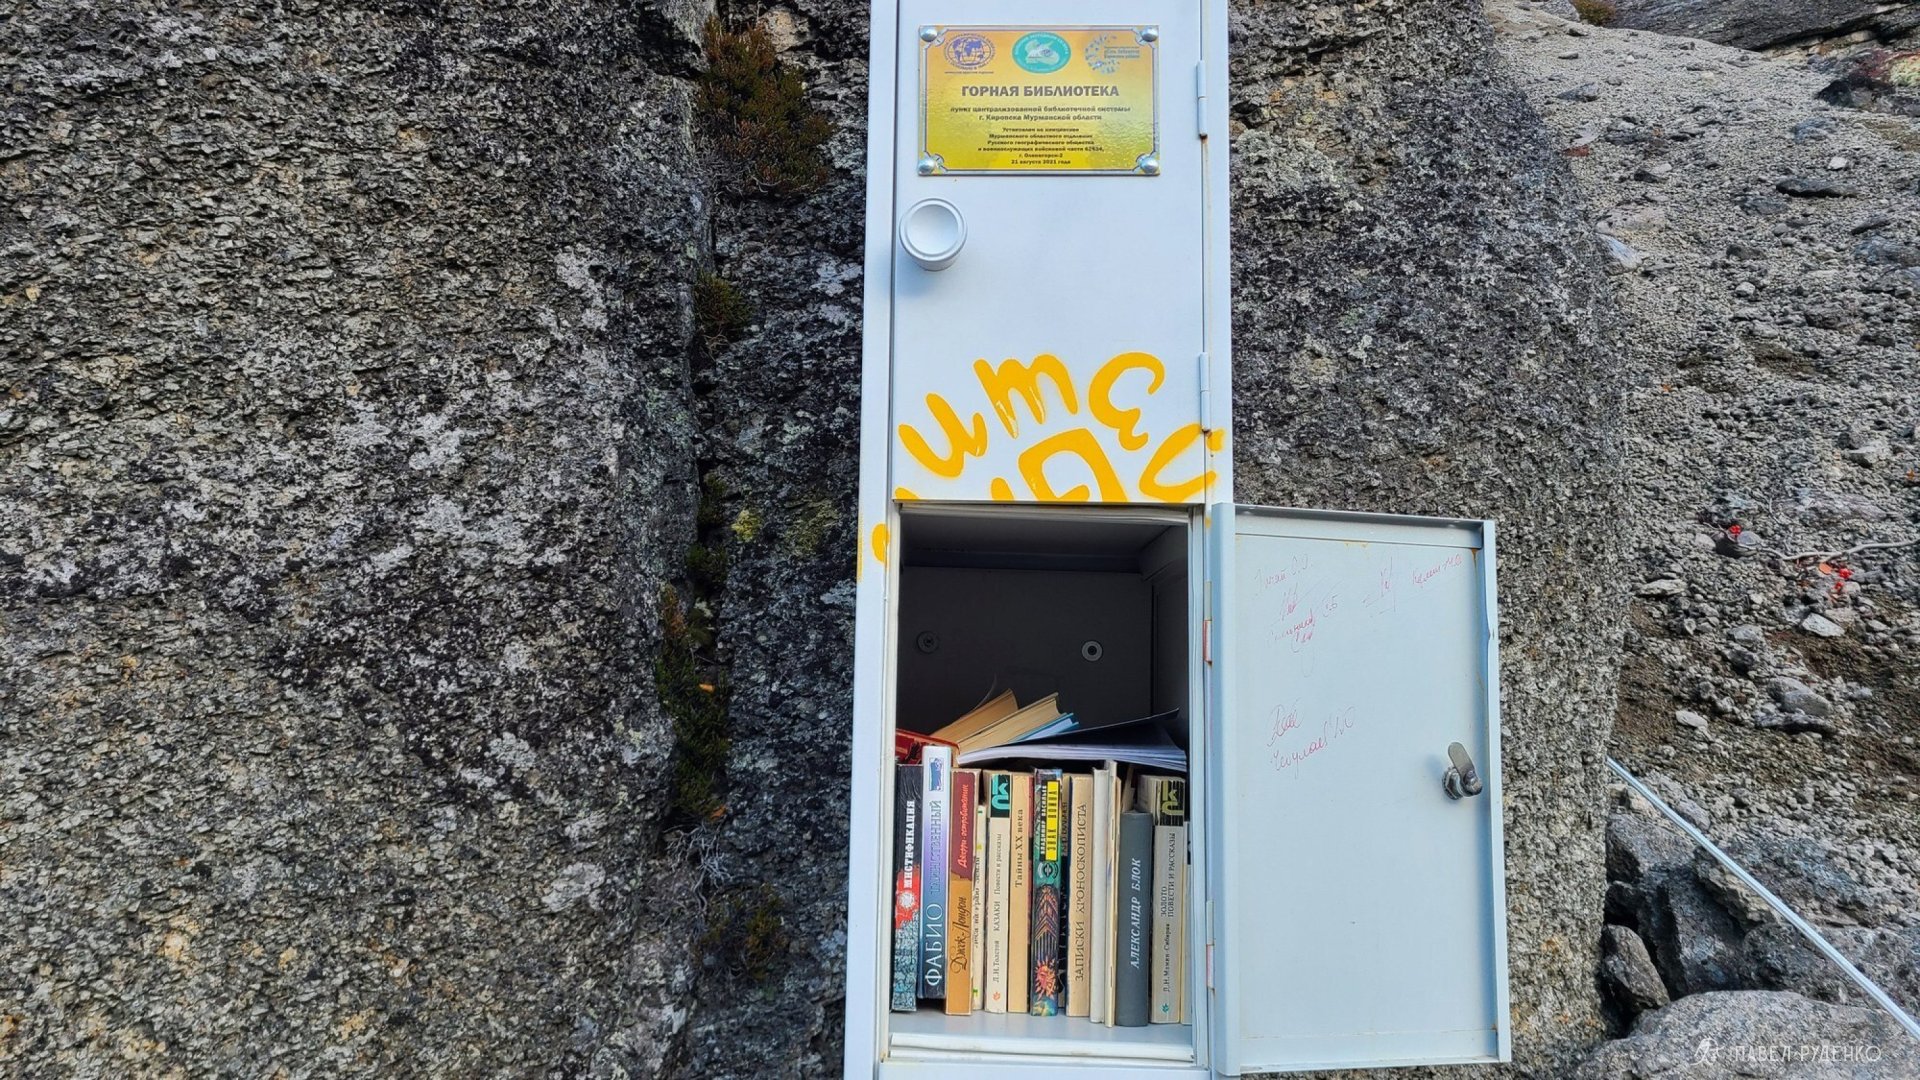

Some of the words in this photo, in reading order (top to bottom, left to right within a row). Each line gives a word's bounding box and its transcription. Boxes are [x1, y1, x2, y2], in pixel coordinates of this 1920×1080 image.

[961, 85, 1019, 97] ГОРНАЯ
[1023, 85, 1119, 97] БИБЛИОТЕКА
[972, 105, 1042, 113] централизованной
[1016, 809, 1024, 834] века
[1047, 790, 1058, 819] ВОИНА
[902, 800, 916, 889] МИСТИФИКАЦИЯ
[929, 799, 943, 893] ТАИНСТВЕННЫЙ
[995, 833, 1003, 863] рассказы
[1047, 828, 1057, 851] ЗНАК
[1168, 832, 1176, 872] РАССКАЗЫ
[1014, 853, 1024, 888] Тайны
[1075, 803, 1087, 914] ХРОНОСКОПИСТА
[1131, 857, 1142, 891] БЛОК
[994, 869, 1002, 895] Повести
[1167, 881, 1176, 918] ПОВЕСТИ
[952, 896, 969, 934] Лондон
[993, 901, 1001, 932] КАЗАКИ
[1160, 886, 1168, 918] ЗОЛОТО
[924, 903, 944, 987] ФАБИО
[1130, 896, 1142, 969] АЛЕКСАНДР
[949, 933, 968, 974] Джек
[1074, 921, 1085, 982] ЗАПИСКИ
